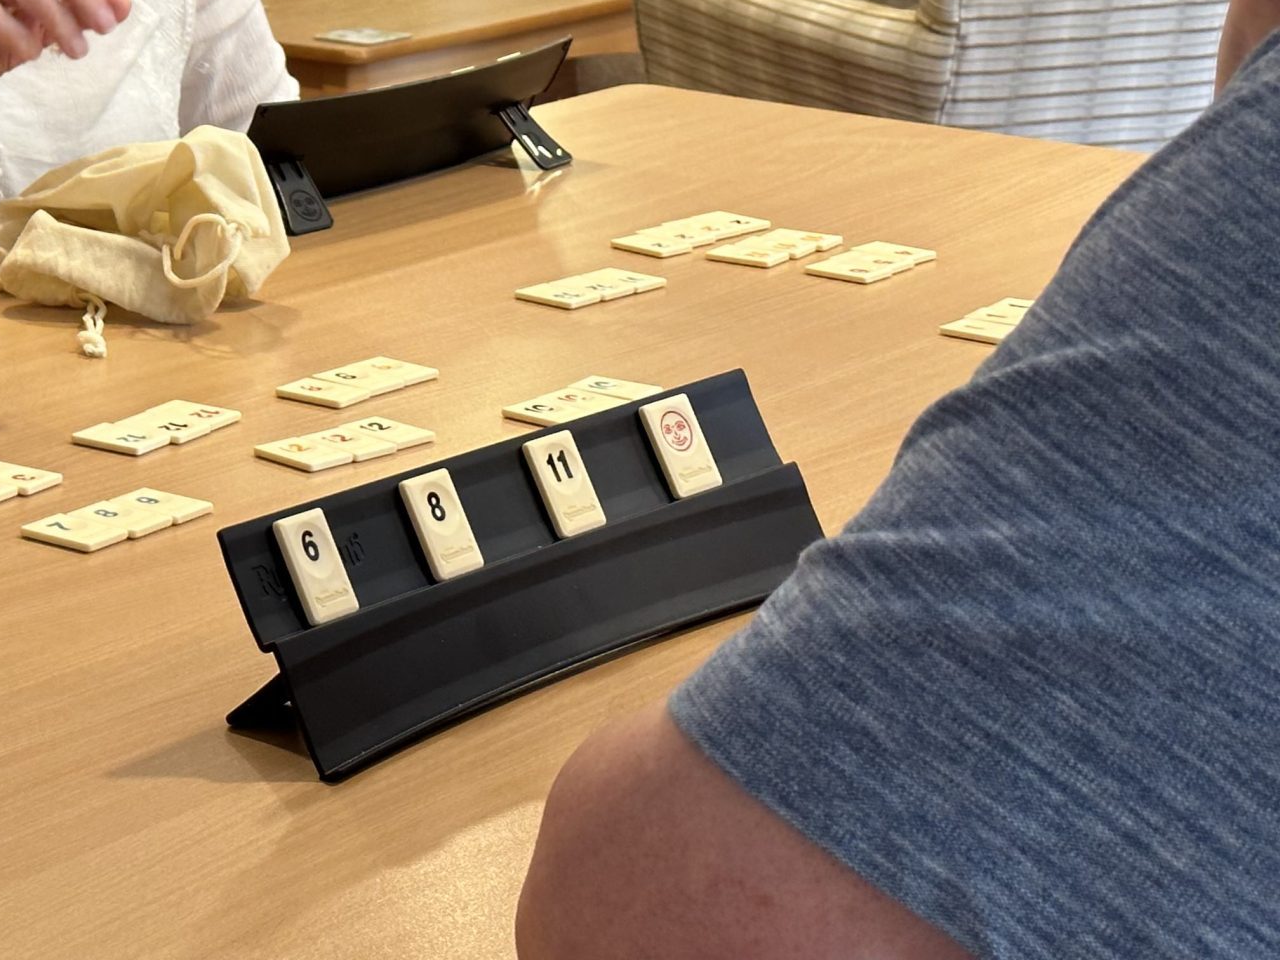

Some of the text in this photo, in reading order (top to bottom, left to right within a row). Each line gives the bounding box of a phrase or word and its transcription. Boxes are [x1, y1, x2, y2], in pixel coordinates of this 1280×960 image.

[158, 422, 188, 431] 12
[359, 421, 392, 432] 12
[321, 434, 353, 443] 12
[545, 448, 575, 483] 11
[426, 491, 447, 522] 8
[93, 509, 119, 518] 8
[45, 521, 72, 531] 7
[301, 530, 320, 563] 6
